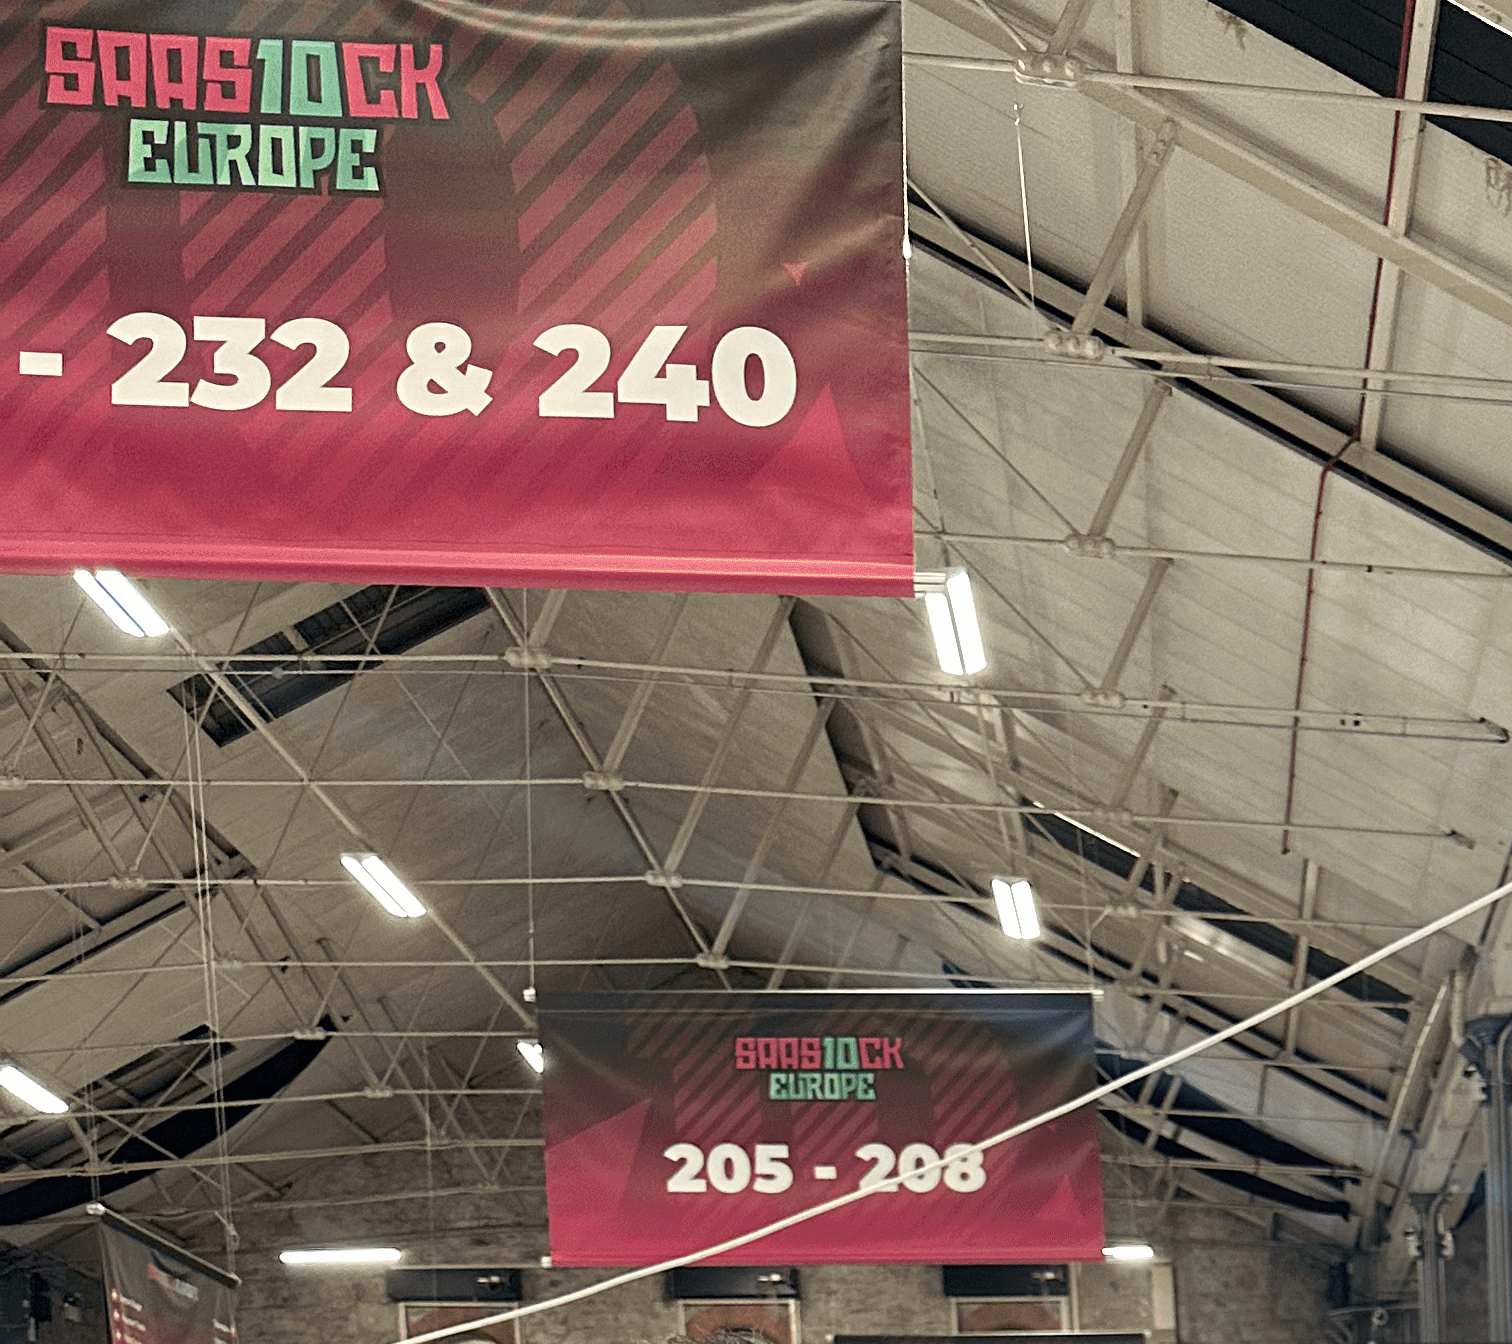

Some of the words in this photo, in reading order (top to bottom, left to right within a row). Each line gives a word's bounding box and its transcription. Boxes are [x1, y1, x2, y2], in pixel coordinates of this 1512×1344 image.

[128, 119, 380, 192] EUROPE
[106, 312, 353, 412] 232
[397, 322, 494, 417] &
[533, 324, 798, 428] 240
[769, 1072, 876, 1101] EUROPE
[663, 1143, 794, 1194] 205
[814, 1164, 837, 1181] -
[855, 1143, 986, 1194] 208
